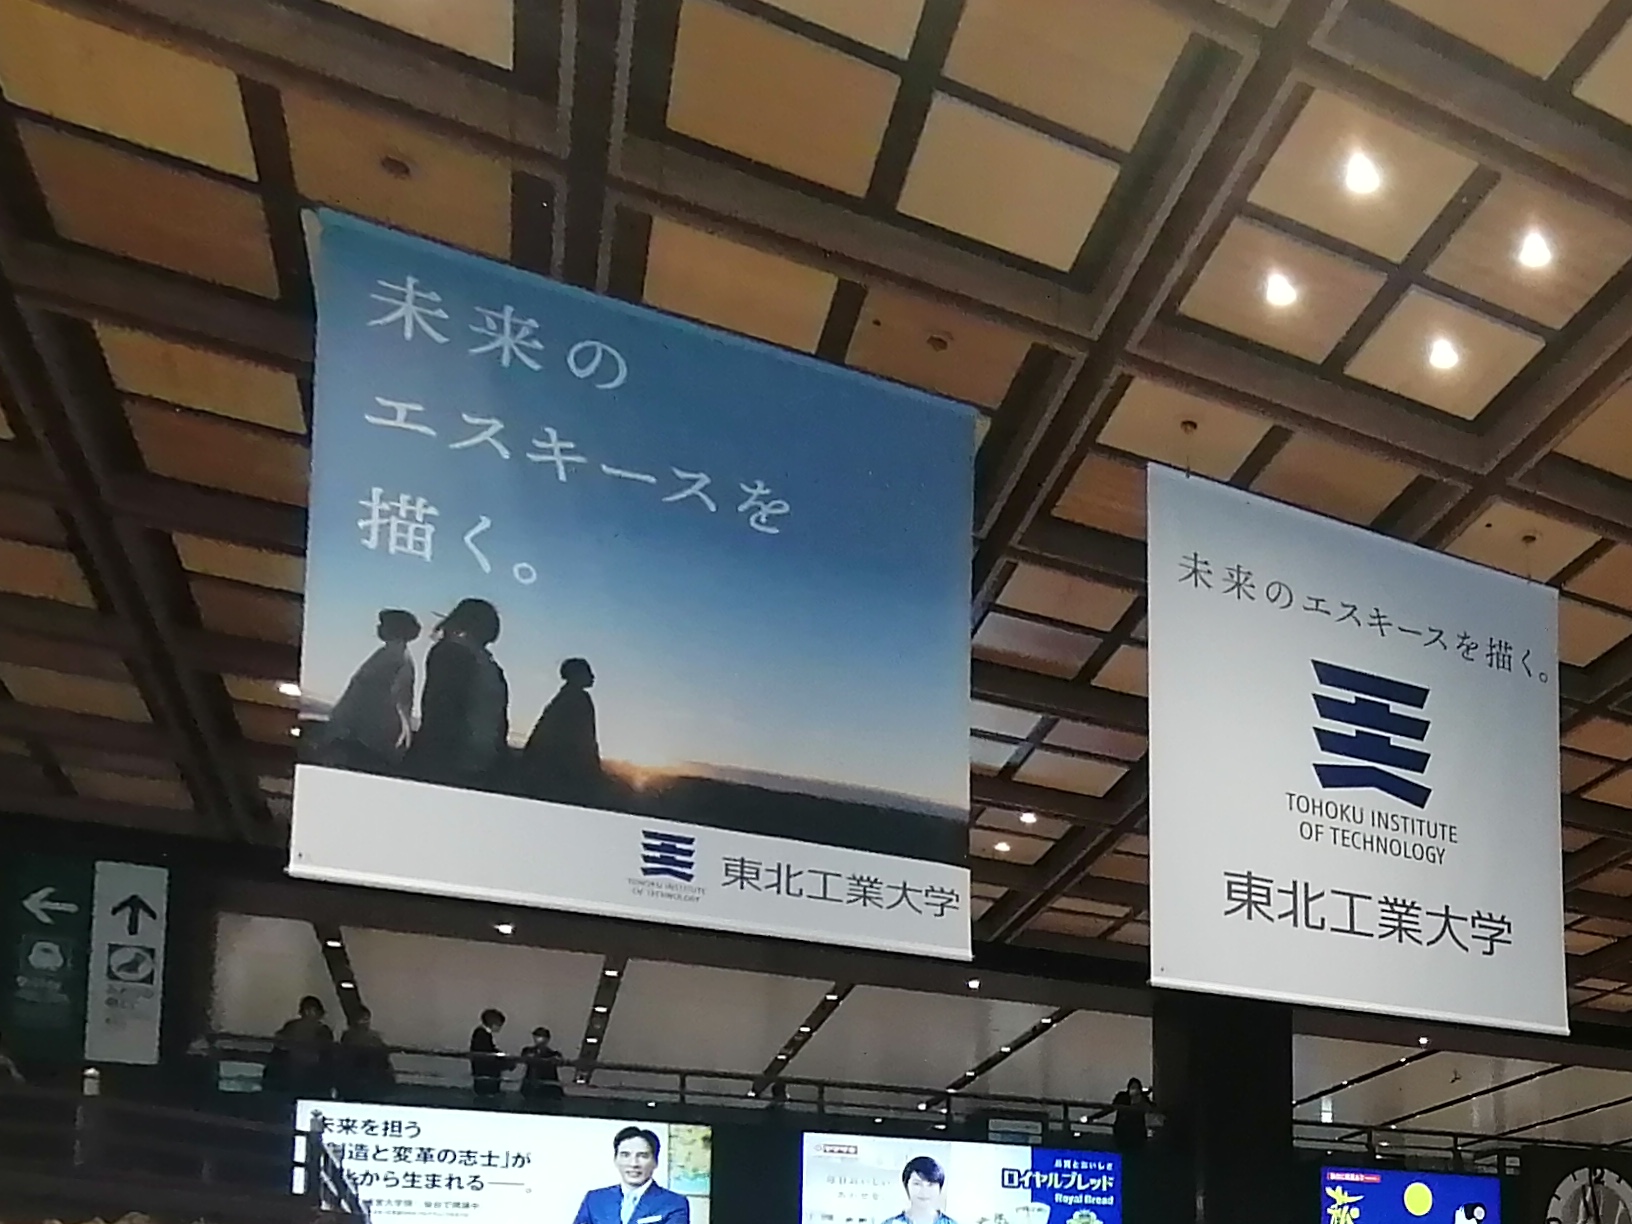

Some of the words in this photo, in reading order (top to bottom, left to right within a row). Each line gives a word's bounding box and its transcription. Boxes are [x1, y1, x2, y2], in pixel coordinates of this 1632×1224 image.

[367, 277, 628, 390] 未来の
[364, 396, 792, 535] エスキースを
[357, 487, 538, 586] 描く。
[1176, 551, 1549, 684] 未来のエスキースを描く。
[1285, 791, 1365, 826] TOHOKU
[1370, 809, 1459, 844] INSTITUTE
[1299, 820, 1325, 843] OF
[1330, 826, 1446, 867] TECHNOLOGY
[720, 856, 961, 918] 東北工業大学
[1222, 869, 1514, 956] 東北工業大学
[1003, 1168, 1115, 1192] ロイヤルブレッド
[1055, 1193, 1084, 1206] Royal
[1085, 1194, 1114, 1206] Bread
